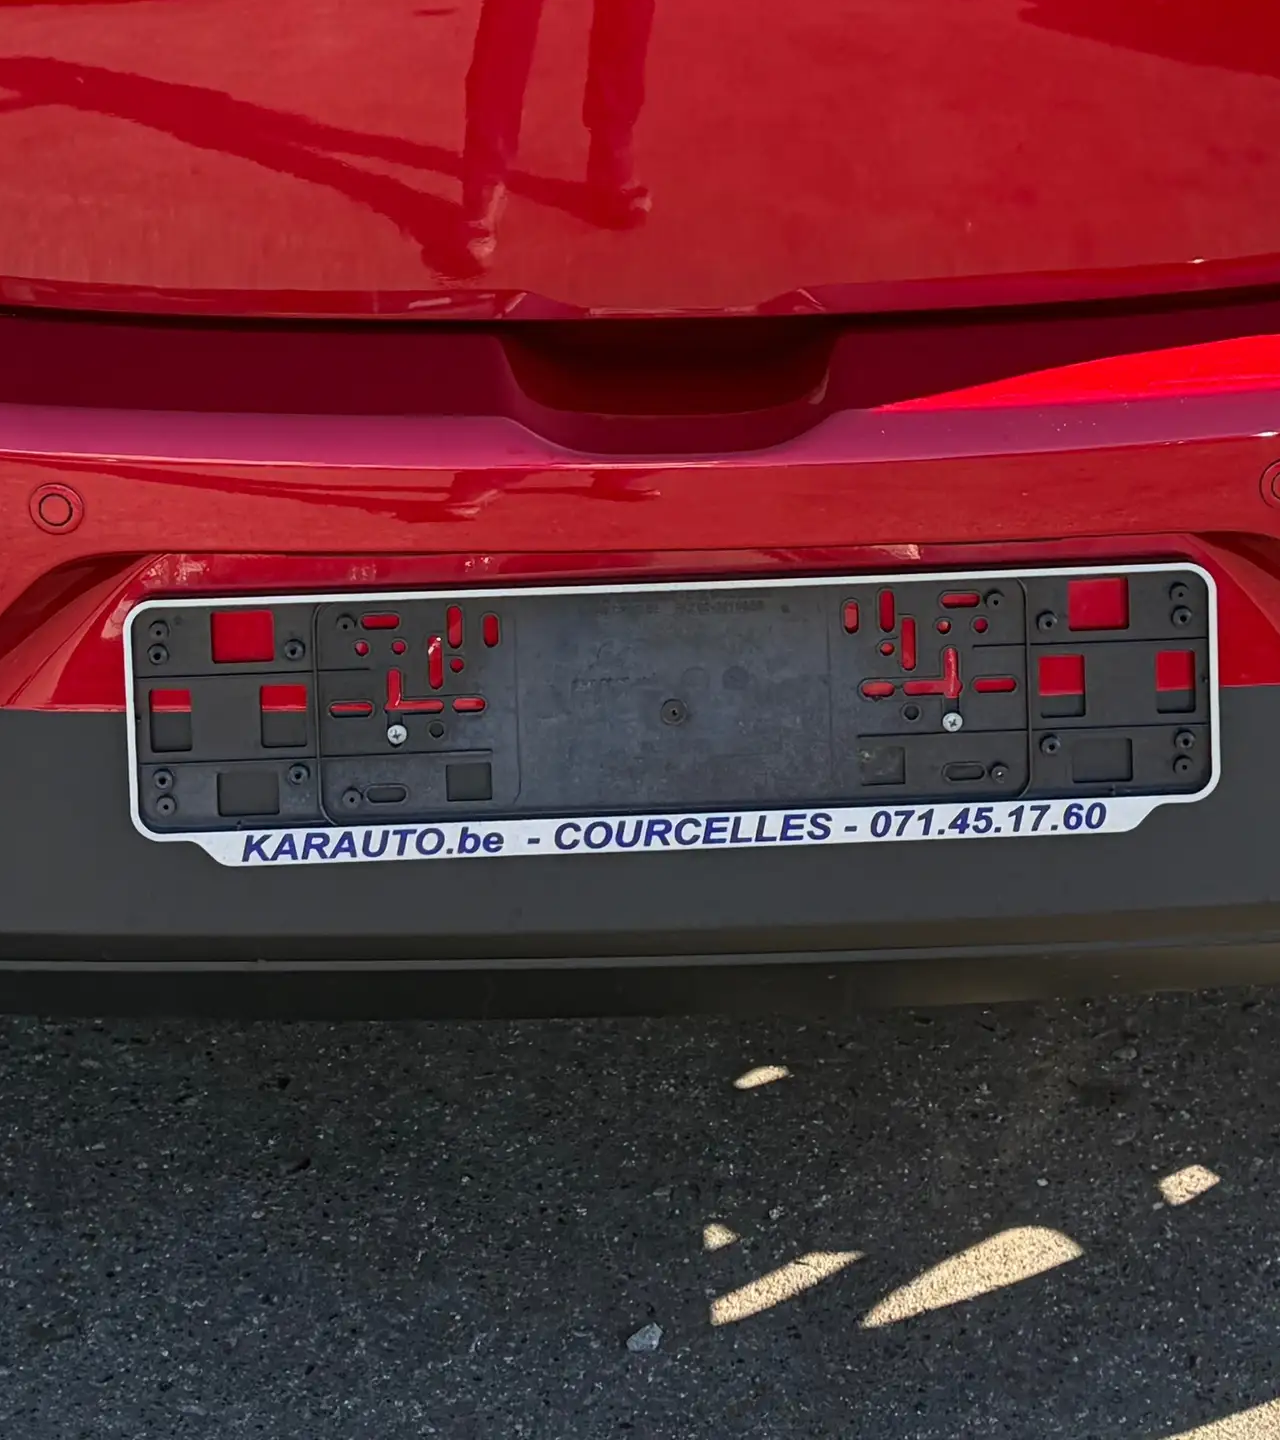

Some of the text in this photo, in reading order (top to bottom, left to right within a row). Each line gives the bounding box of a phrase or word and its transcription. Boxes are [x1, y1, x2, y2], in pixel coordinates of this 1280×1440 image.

[241, 826, 505, 863] KARAUTO.be
[554, 812, 833, 850] COURCELLES
[870, 802, 1107, 838] 071.45.17.60
